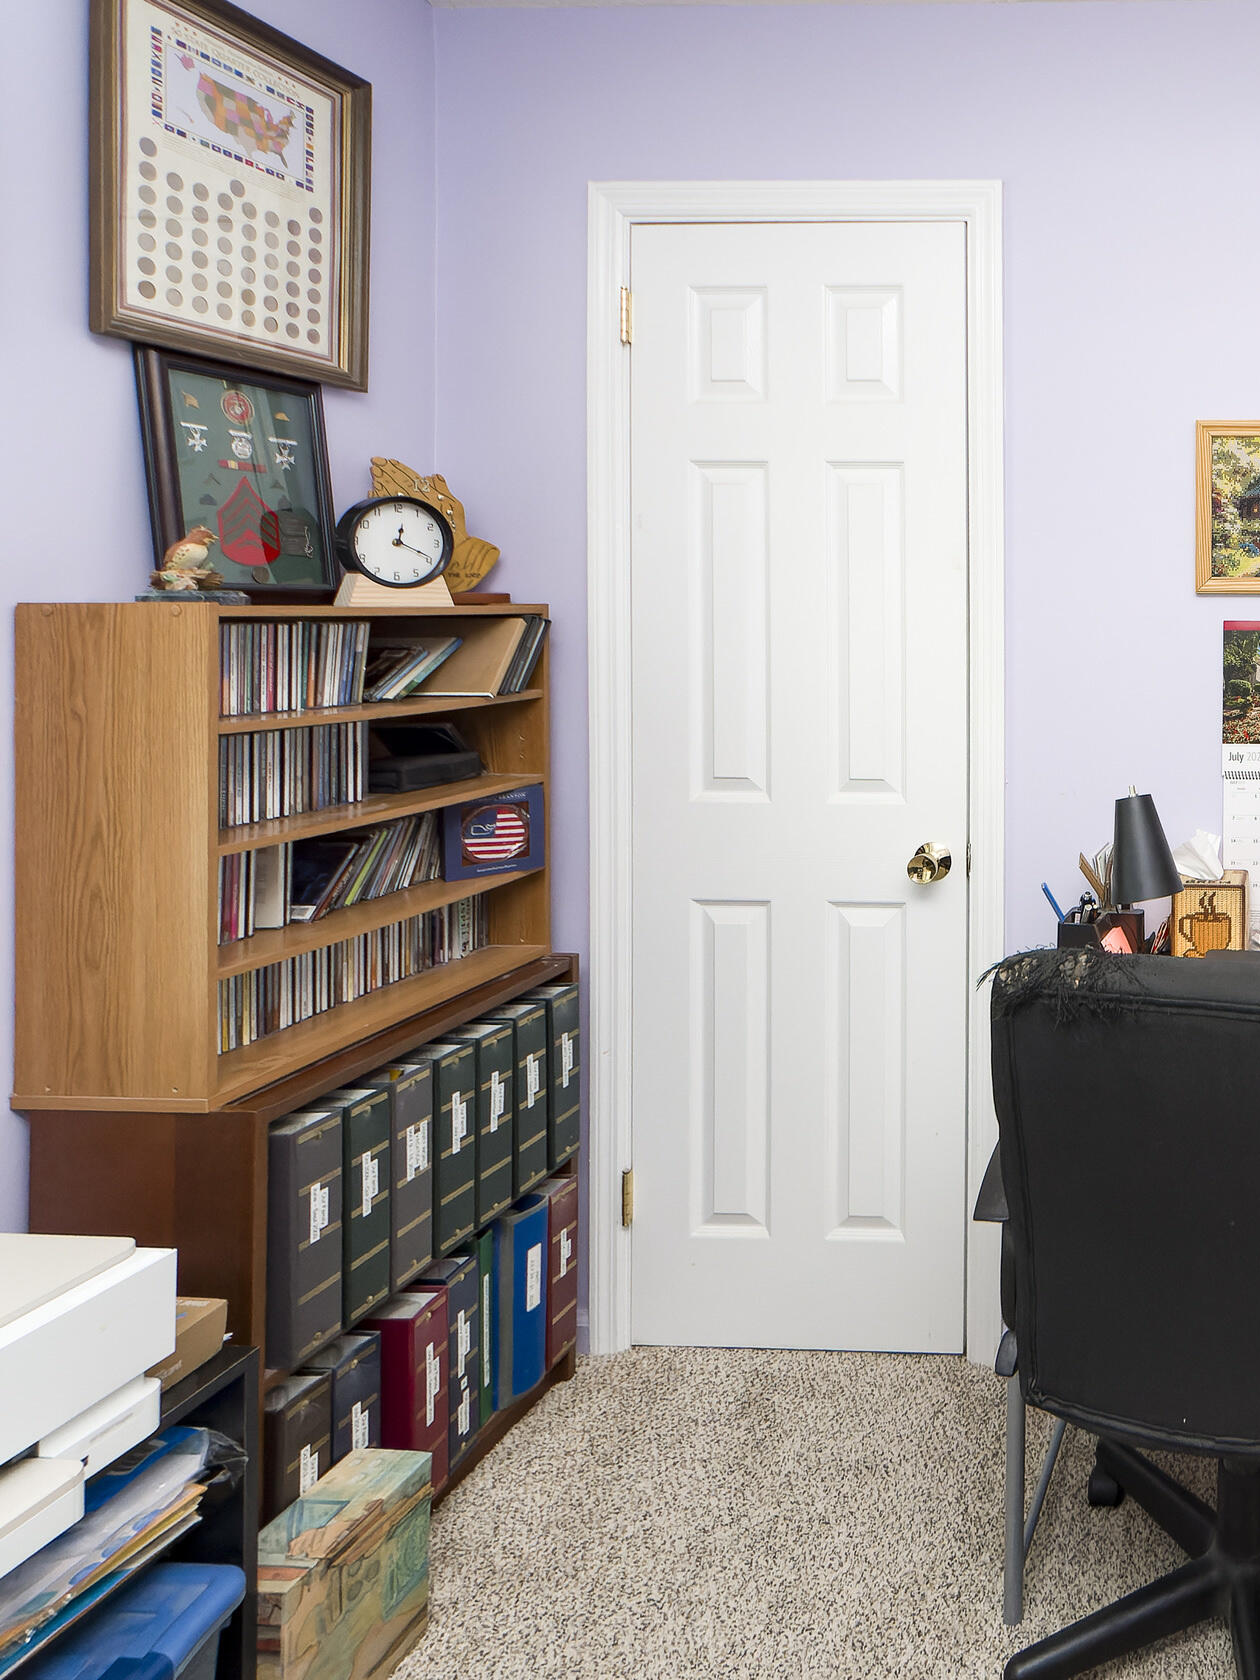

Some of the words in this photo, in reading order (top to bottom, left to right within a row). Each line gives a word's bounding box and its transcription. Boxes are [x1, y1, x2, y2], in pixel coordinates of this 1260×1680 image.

[413, 479, 431, 493] 12
[374, 507, 380, 516] 11
[394, 503, 403, 513] 12
[360, 520, 369, 529] 10
[427, 522, 434, 532] 2
[434, 539, 440, 549] 3
[426, 556, 433, 566] 4
[374, 567, 380, 576] 7
[393, 571, 401, 581] 6
[413, 568, 419, 578] 5
[1228, 751, 1244, 764] July
